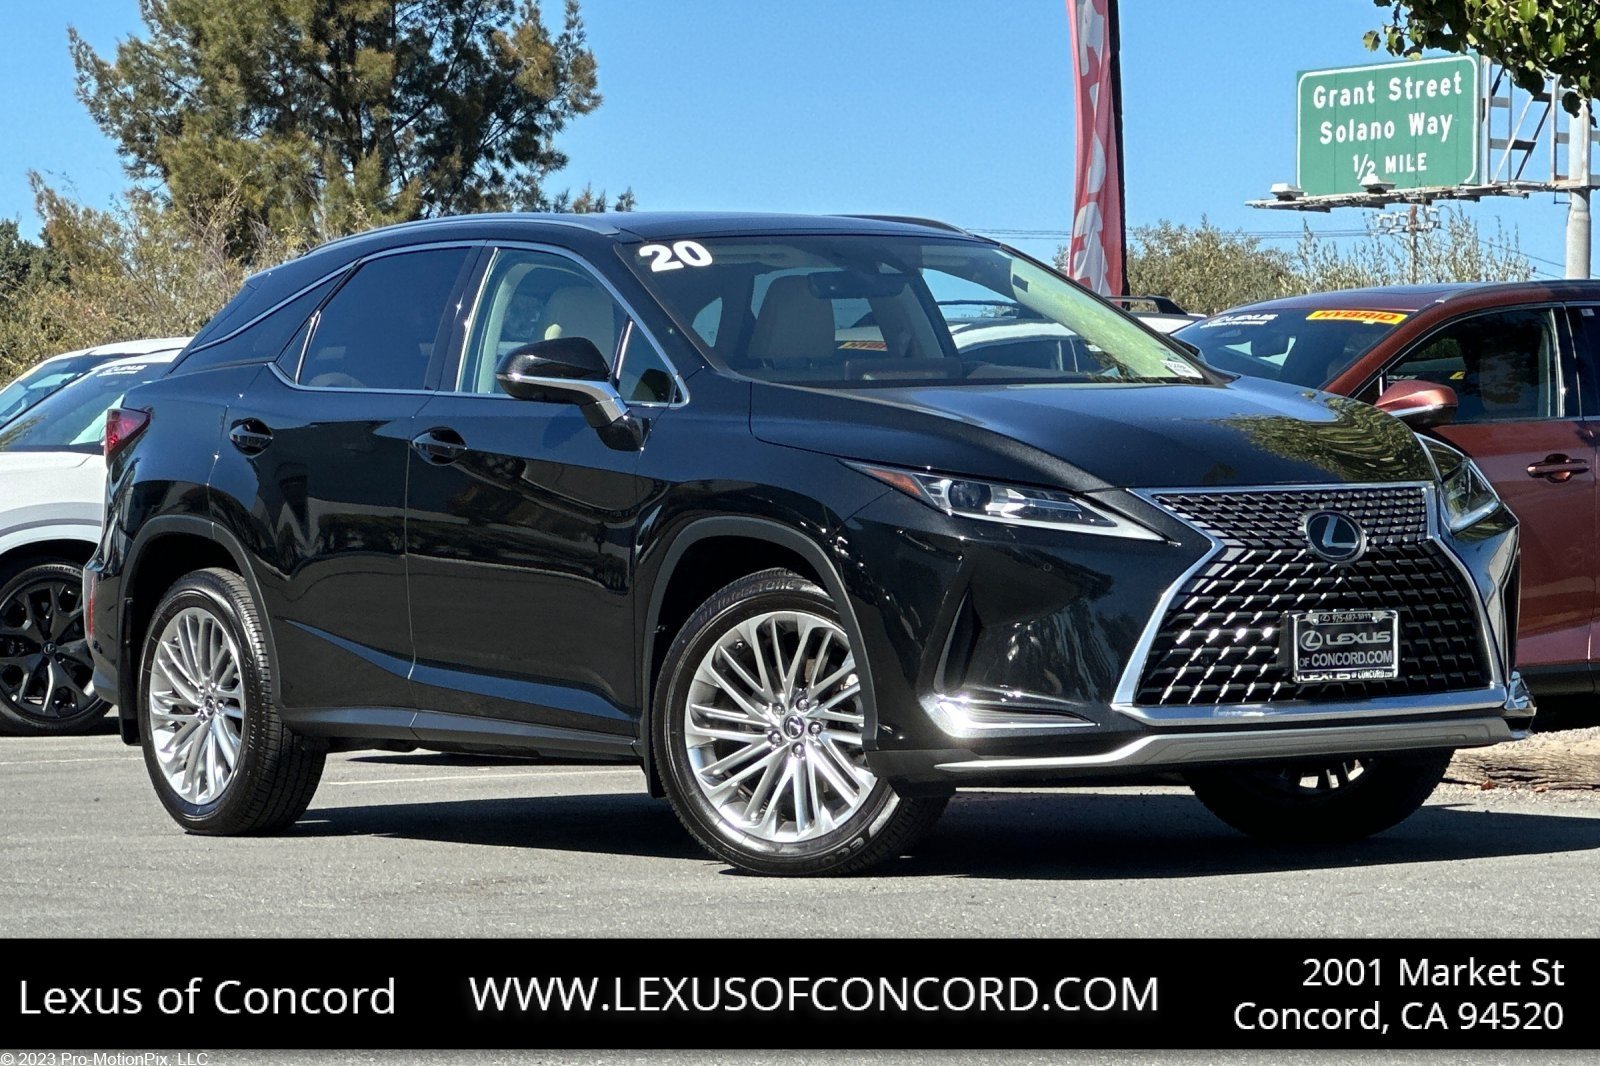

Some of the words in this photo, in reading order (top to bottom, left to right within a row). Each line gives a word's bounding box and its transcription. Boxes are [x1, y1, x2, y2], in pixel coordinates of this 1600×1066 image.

[1313, 80, 1375, 109] Grant
[1388, 71, 1462, 102] Street
[1319, 118, 1395, 145] Solano
[1408, 112, 1453, 143] Way
[1385, 152, 1427, 174] MILE
[638, 240, 713, 272] 20
[1314, 311, 1399, 321] HYBRID
[1325, 631, 1391, 645] LEXUS
[1299, 657, 1310, 668] OF
[1311, 650, 1393, 667] CONCORD.COM
